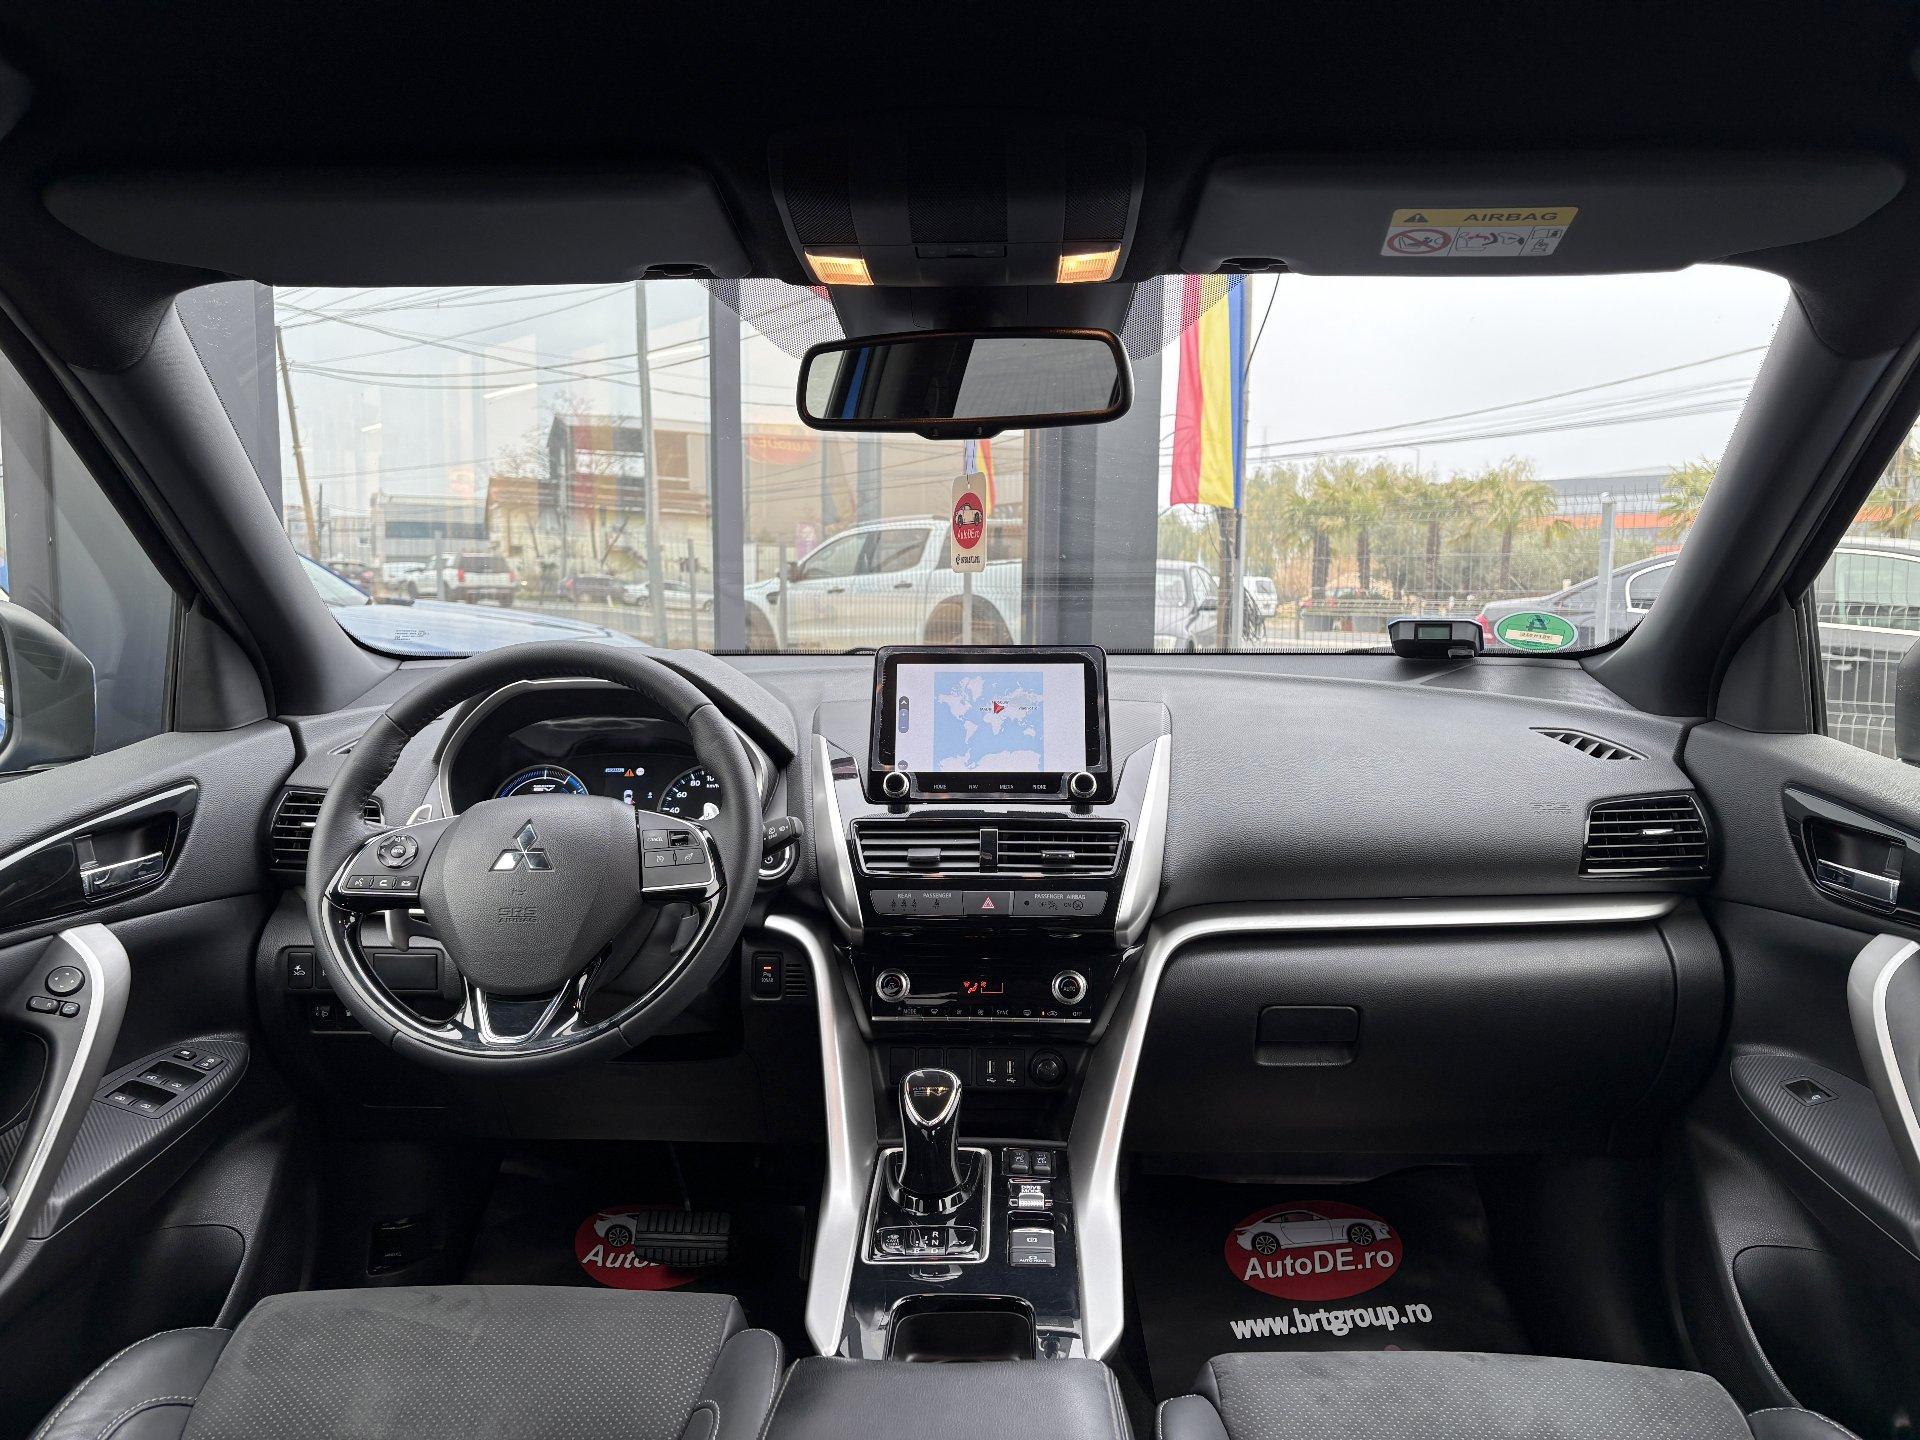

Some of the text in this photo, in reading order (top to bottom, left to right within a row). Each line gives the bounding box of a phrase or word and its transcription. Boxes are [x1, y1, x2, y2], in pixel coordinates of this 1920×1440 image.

[1464, 212, 1558, 222] AIRBAG
[499, 907, 537, 917] SRS
[1243, 1247, 1394, 1281] AutoDE.ro
[1229, 1302, 1433, 1340] www.brtgroup.ro
